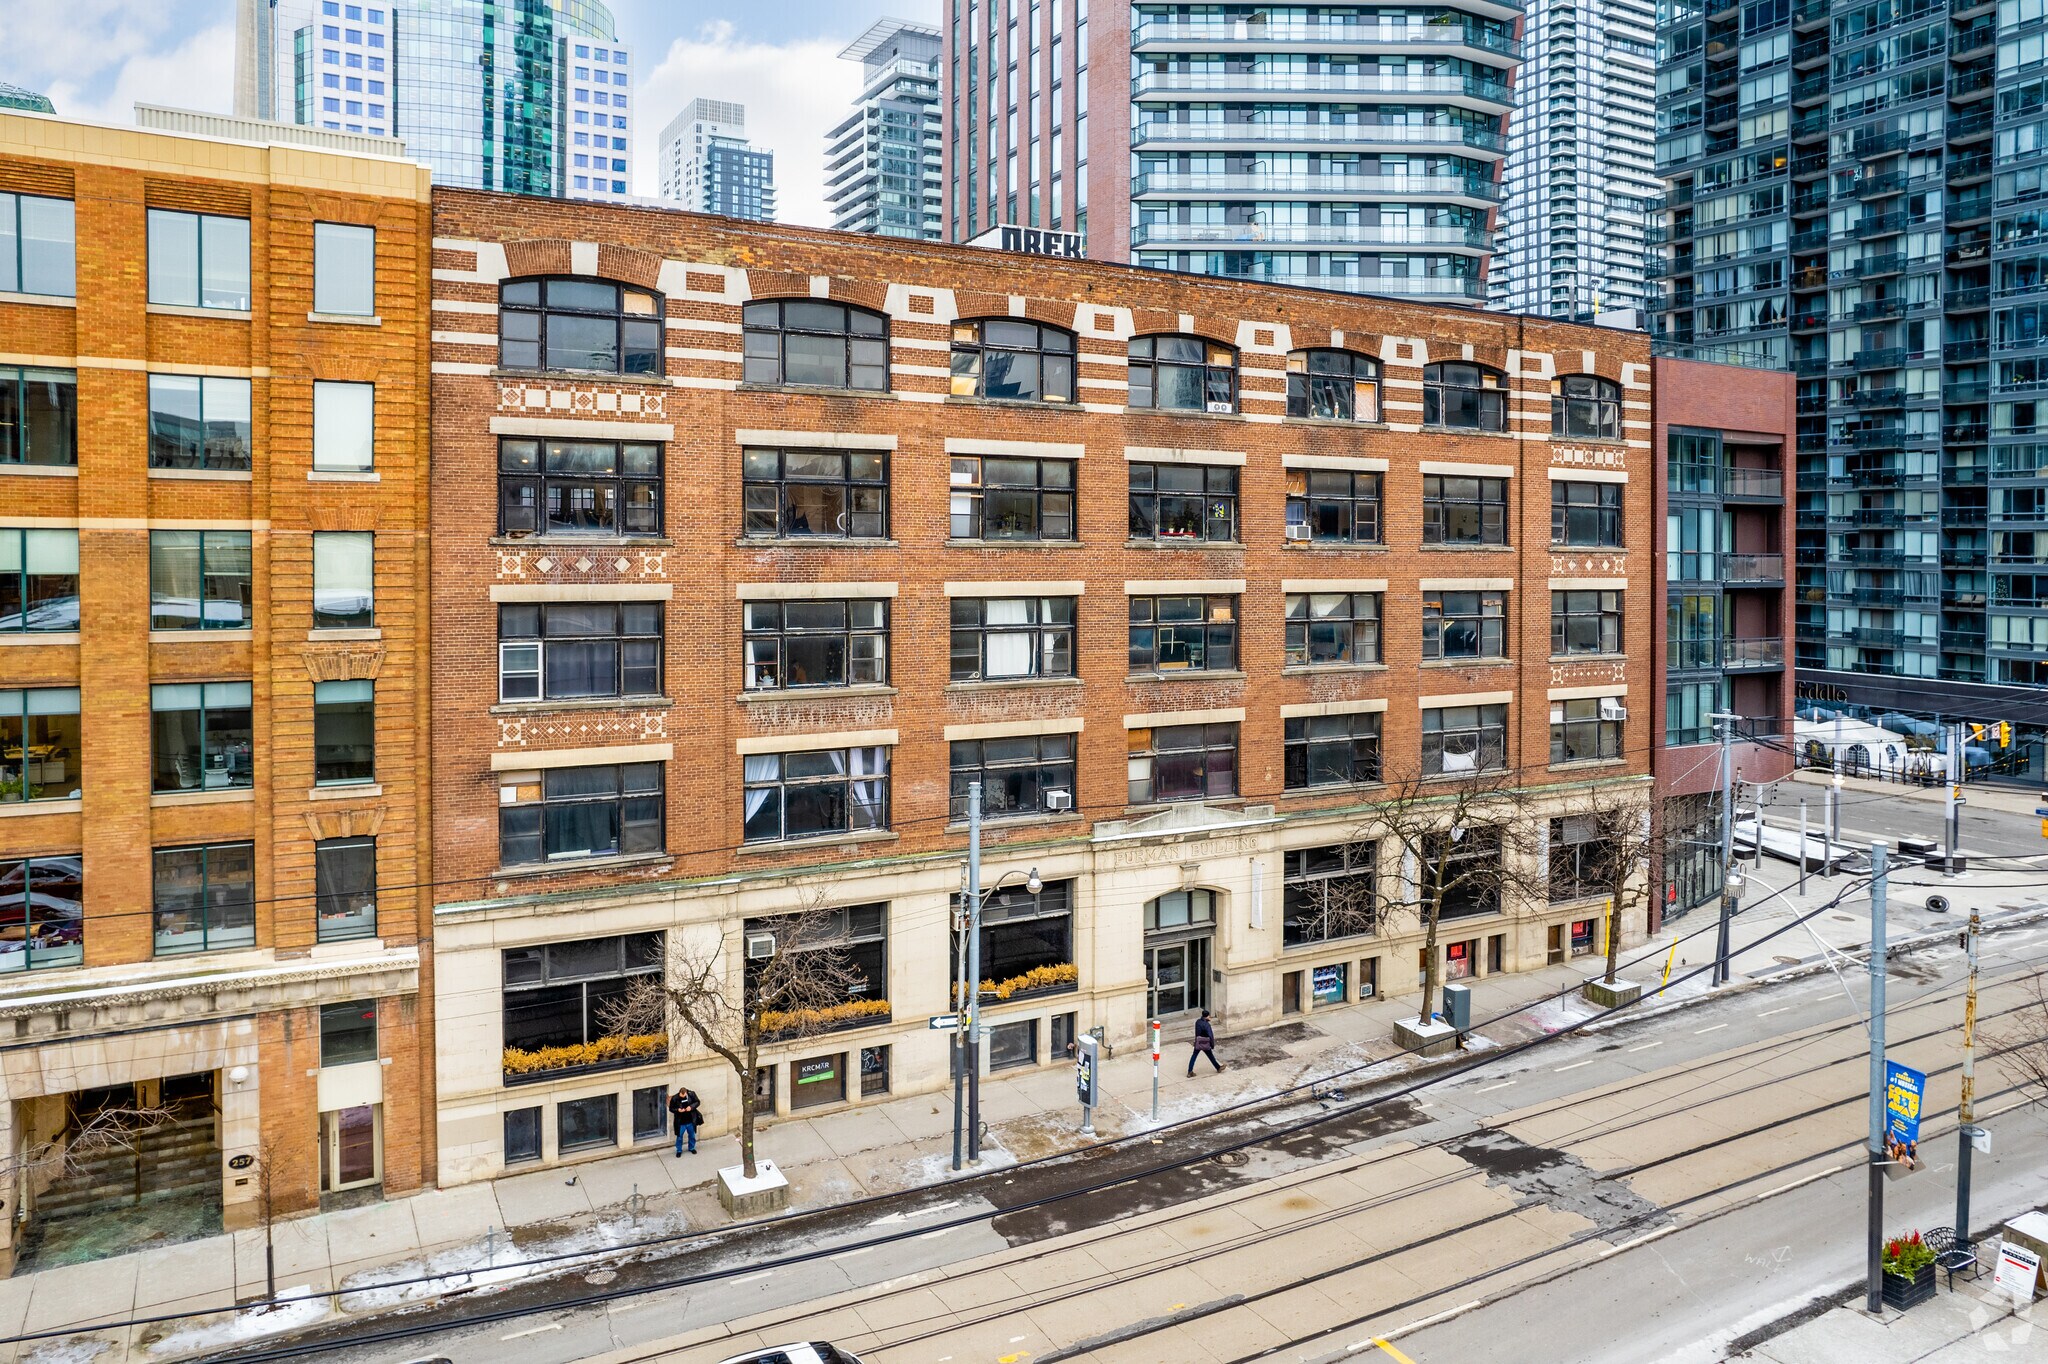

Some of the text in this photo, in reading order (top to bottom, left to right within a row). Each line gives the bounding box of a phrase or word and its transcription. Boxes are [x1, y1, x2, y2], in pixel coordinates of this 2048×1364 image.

[1114, 837, 1258, 866] PURMAN BUILDING
[232, 1156, 251, 1167] 257
